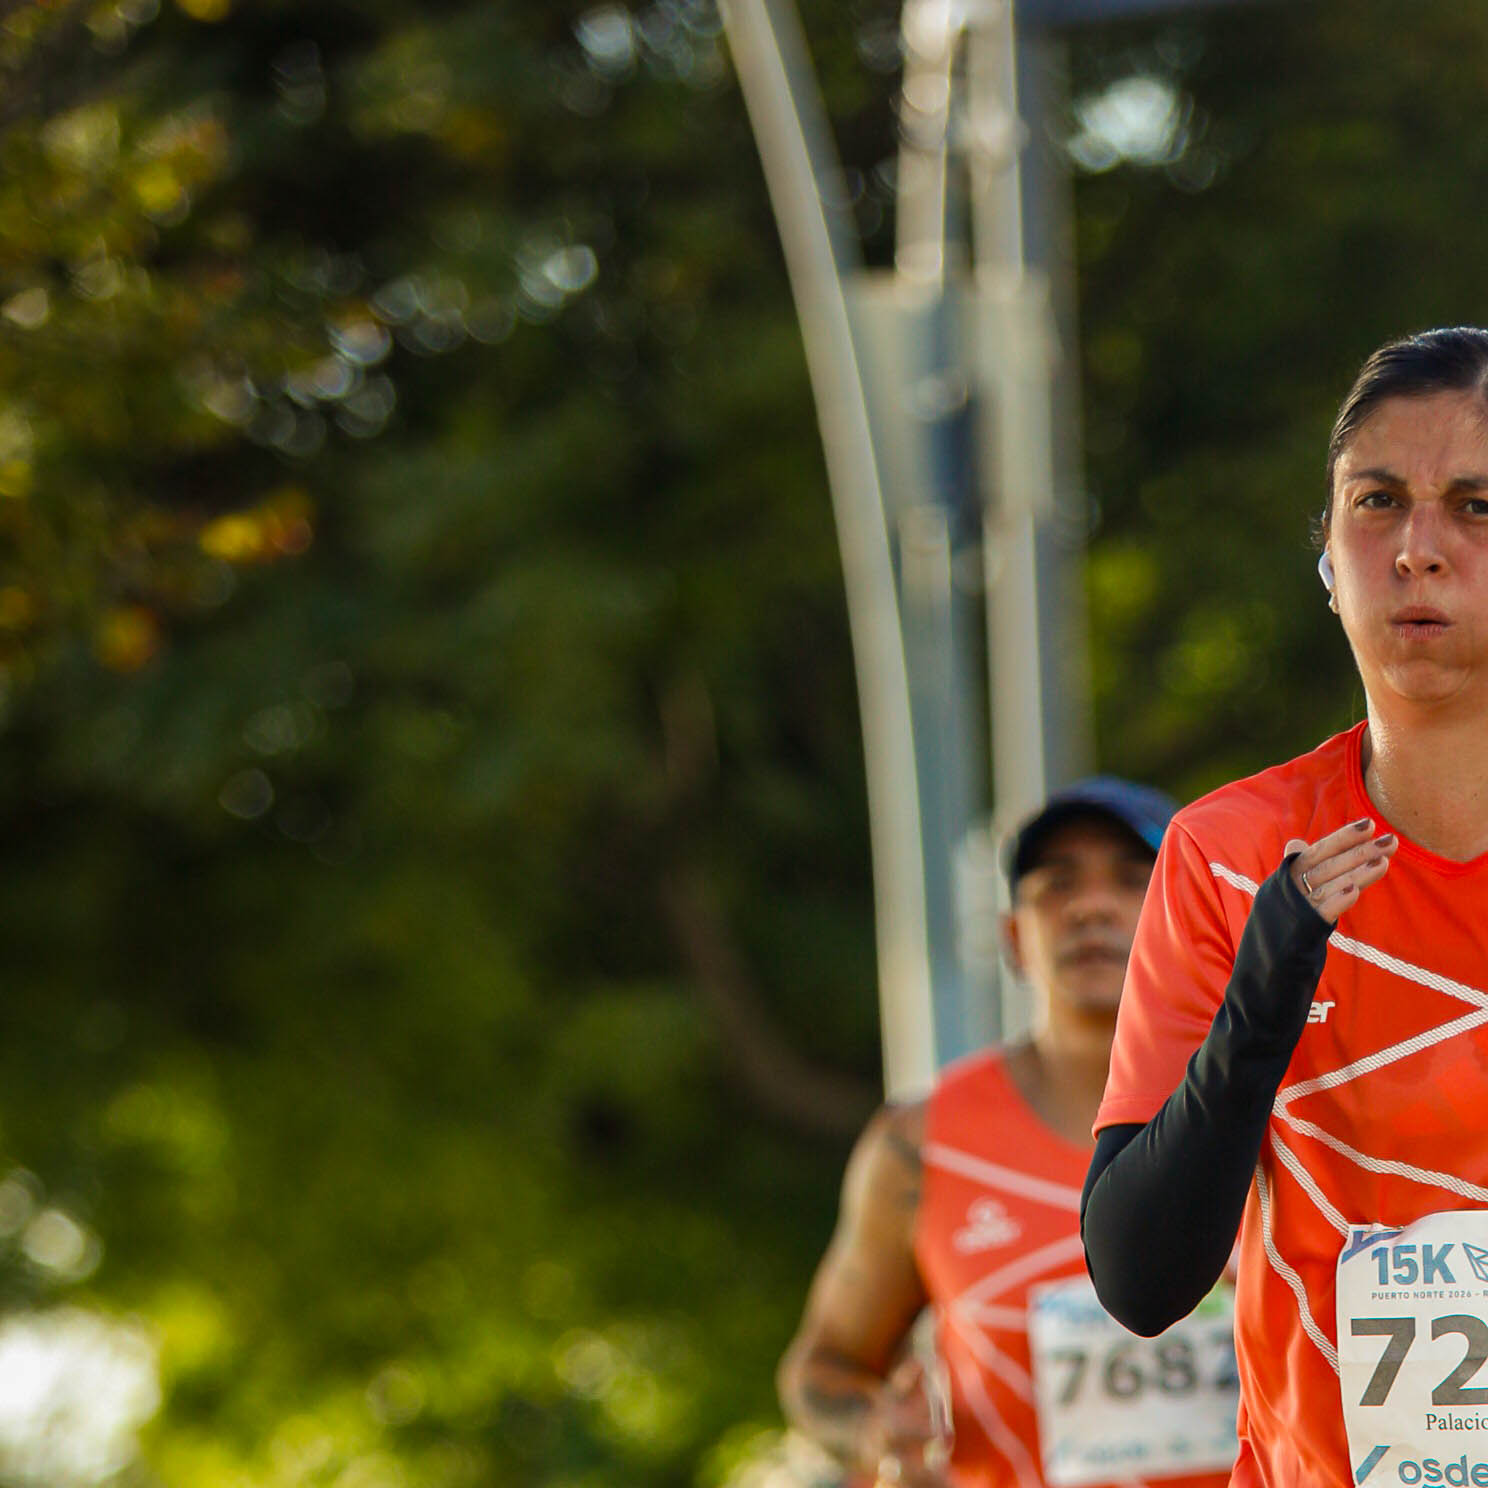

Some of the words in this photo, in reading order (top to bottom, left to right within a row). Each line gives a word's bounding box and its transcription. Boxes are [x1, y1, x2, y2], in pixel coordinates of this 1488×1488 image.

[1371, 1243, 1457, 1285] 15K
[1371, 1291, 1410, 1300] PUERTO
[1413, 1290, 1445, 1299] NORTE
[1448, 1289, 1472, 1298] 2026
